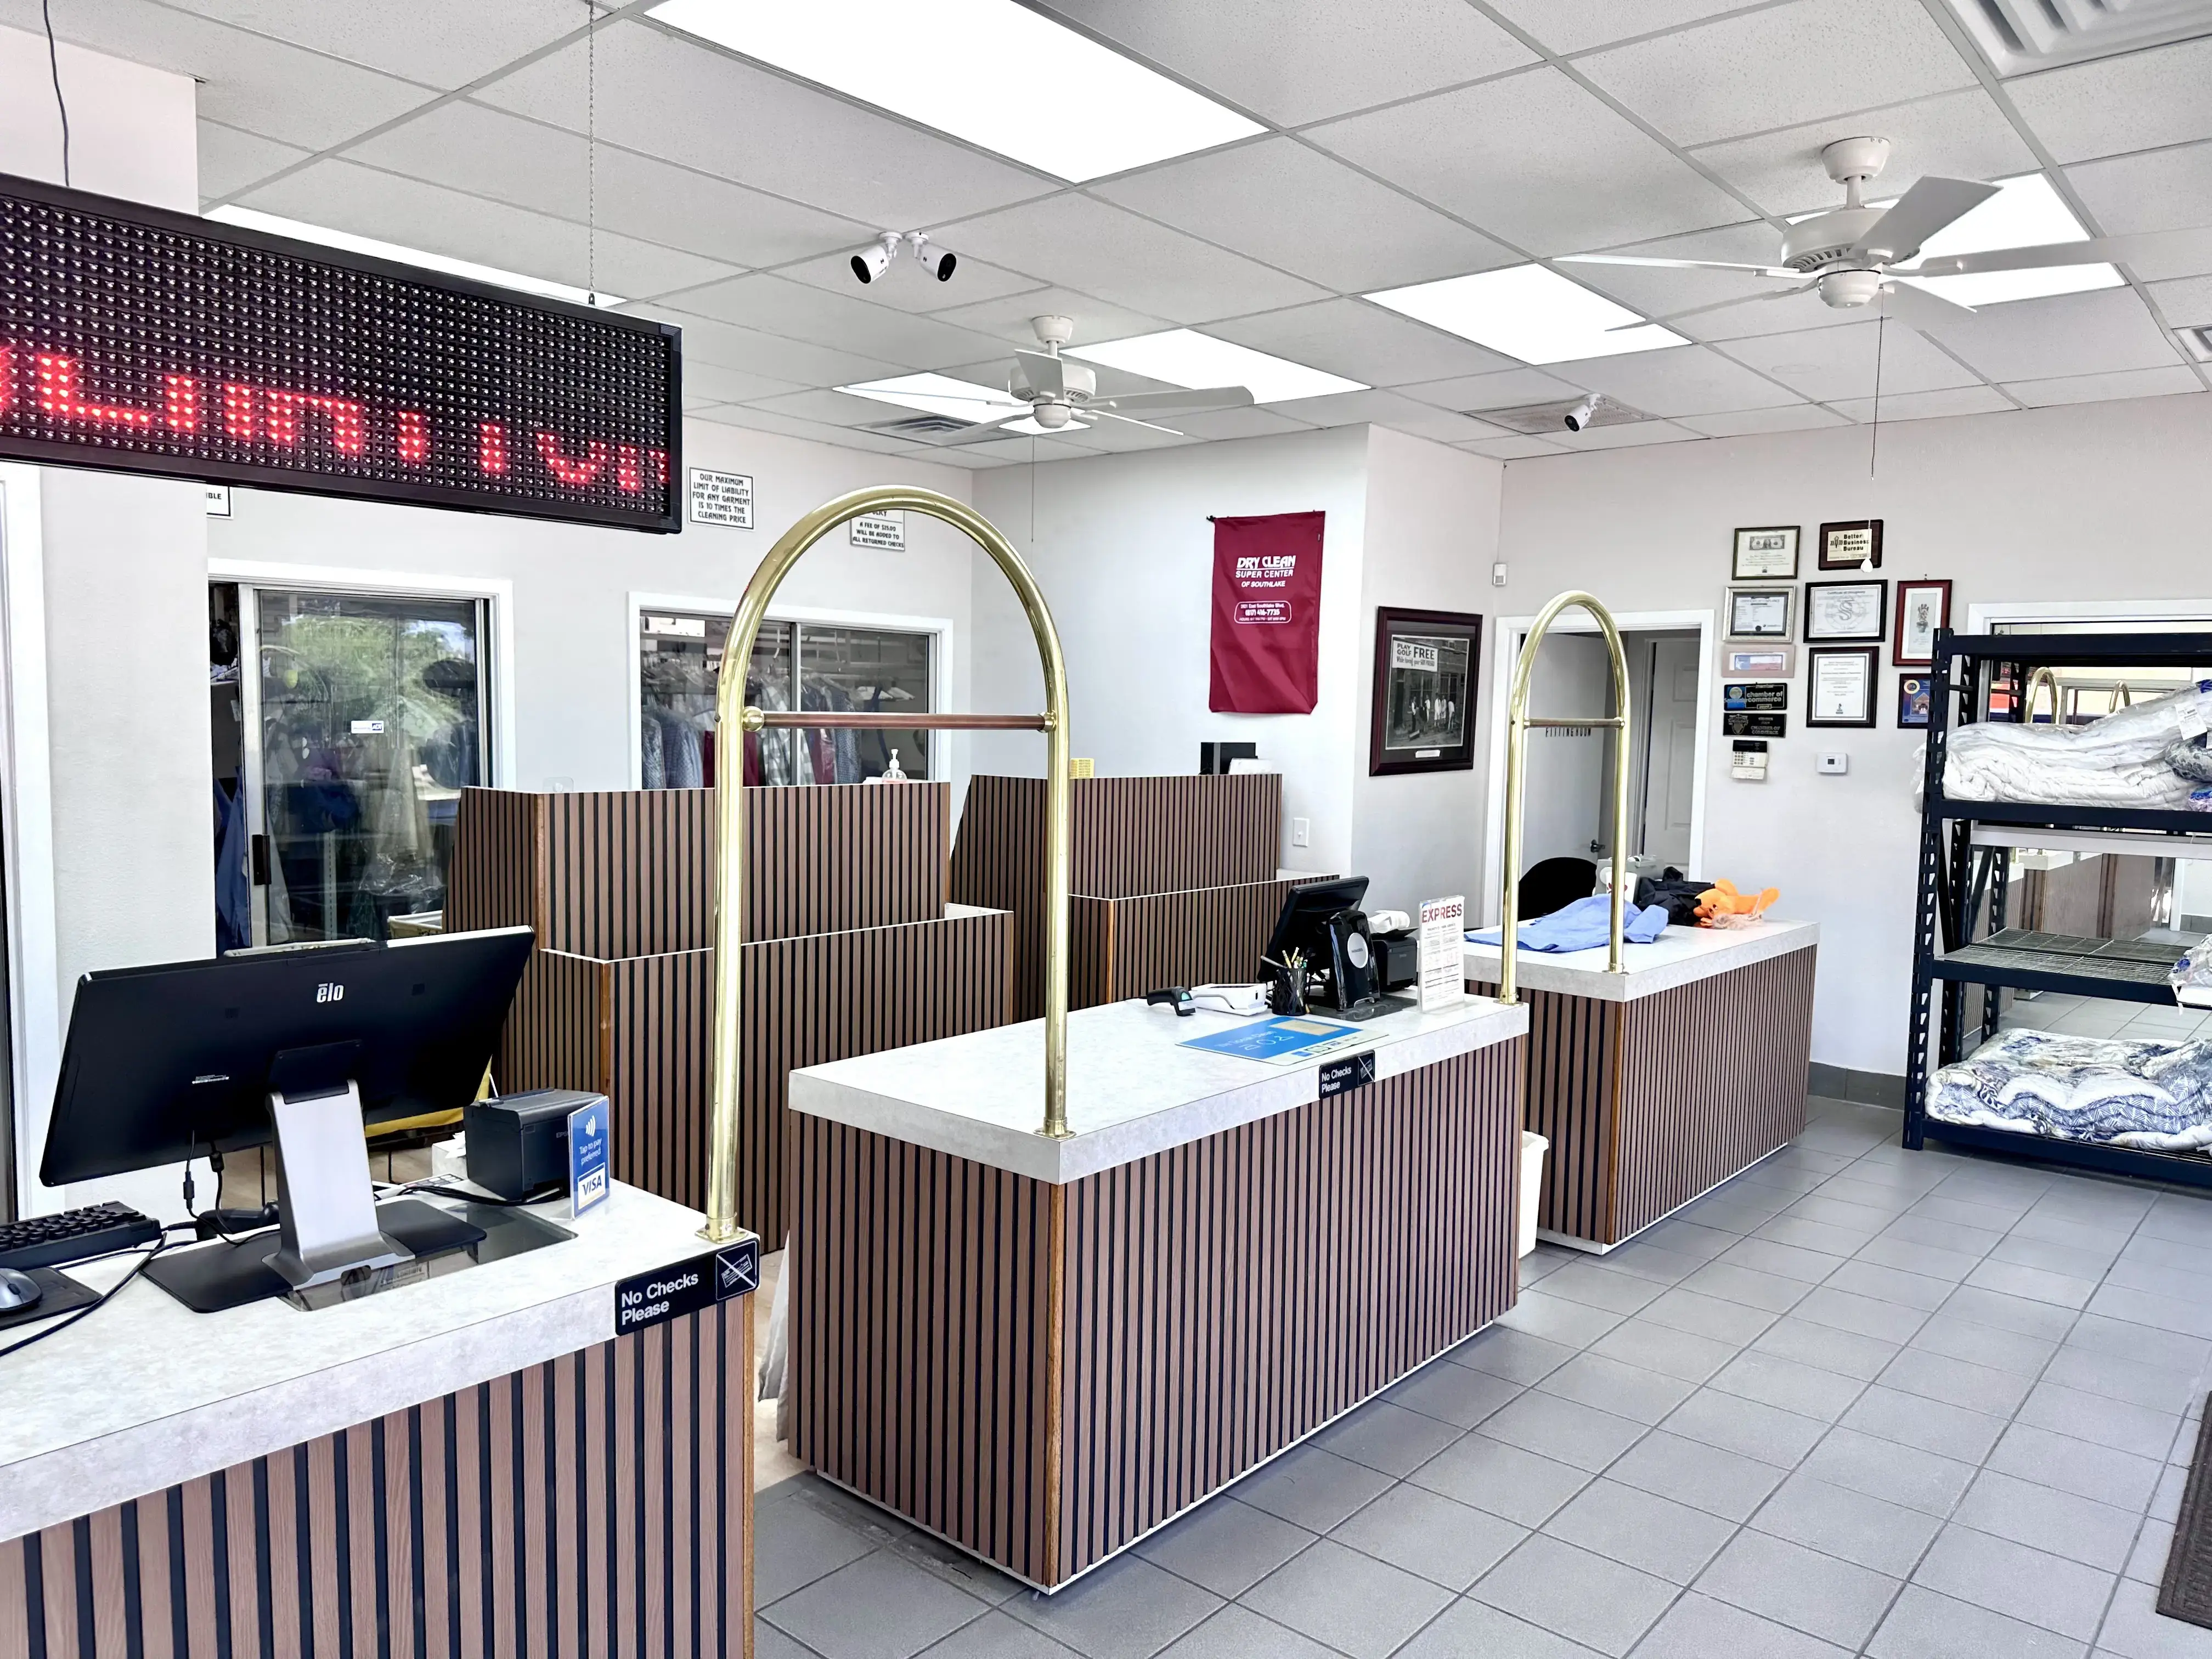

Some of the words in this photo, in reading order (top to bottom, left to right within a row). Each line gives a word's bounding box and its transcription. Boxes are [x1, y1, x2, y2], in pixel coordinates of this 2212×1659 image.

[699, 473, 713, 482] OUR
[715, 476, 743, 486] MAXIMUM
[693, 482, 709, 490] LIMIT
[721, 486, 749, 496] LIABILITY
[692, 492, 705, 500] FOR
[708, 494, 719, 502] ANY
[722, 496, 750, 505] GARMENT
[714, 504, 731, 512] TIMES
[734, 506, 744, 514] THE
[698, 511, 727, 521] CLEANING
[729, 515, 746, 523] PRICE
[1237, 557, 1260, 569] DRY
[1262, 555, 1296, 568] CLEAN
[1264, 569, 1293, 578] CENTER
[1414, 646, 1435, 660] FREE
[1422, 903, 1462, 923] EXPRESS
[1322, 1072, 1330, 1082] No
[1331, 1066, 1352, 1079] Checks
[1322, 1081, 1340, 1093] Please
[579, 1145, 588, 1154] Tap
[588, 1142, 594, 1150] to
[594, 1138, 602, 1149] pay
[581, 1147, 601, 1166] preferred
[582, 1175, 602, 1195] VISA
[621, 1290, 642, 1308] No
[646, 1273, 699, 1299] Checks
[622, 1301, 670, 1326] Please
